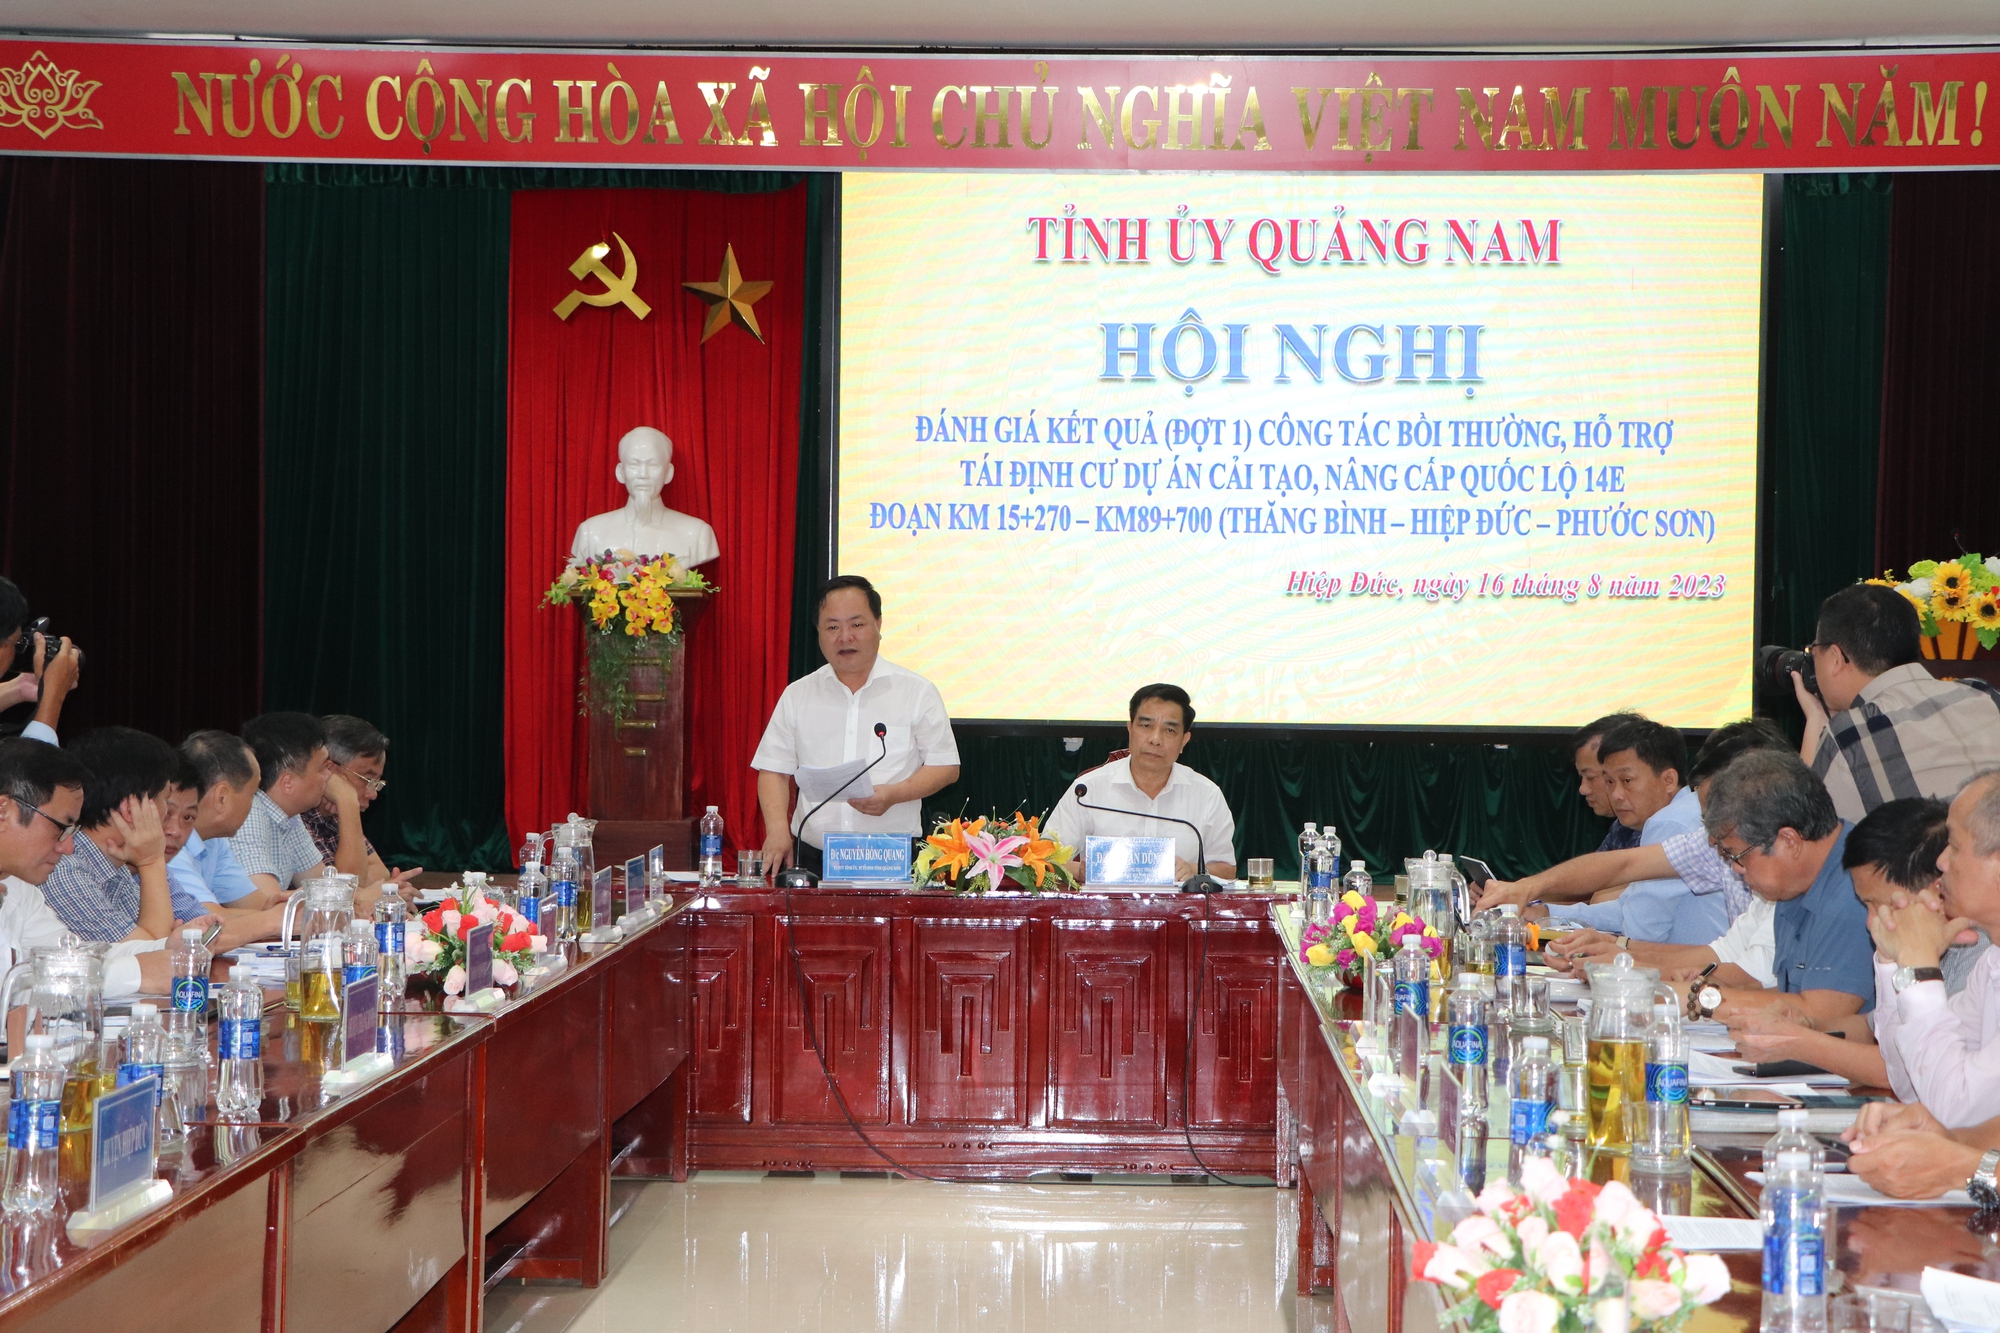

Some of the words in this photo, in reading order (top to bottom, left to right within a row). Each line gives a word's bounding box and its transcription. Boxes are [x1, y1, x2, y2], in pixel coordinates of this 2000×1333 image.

[171, 55, 347, 142] NƯỚC
[364, 58, 535, 156] CỘNG
[553, 62, 686, 146] HÒA
[697, 66, 780, 147] XÃ
[798, 65, 914, 162] HỘI
[930, 60, 1060, 151] CHỦ
[1075, 68, 1275, 152] NGHĨA
[1290, 71, 1435, 165] VIỆT
[1452, 84, 1592, 152] NAM
[1606, 66, 1802, 151] MUÔN
[1815, 63, 1989, 149] NĂM!
[1028, 204, 1149, 262] TỈNH
[1167, 204, 1236, 263] ỦY
[1247, 205, 1430, 273] QUẢNG
[1444, 218, 1563, 264] NAM
[1098, 306, 1252, 396] HỘI
[1274, 322, 1486, 398] NGHỊ
[915, 408, 990, 444] ĐÁNH
[993, 409, 1039, 444] GIÁ
[1046, 409, 1098, 446] KẾT
[1103, 410, 1159, 450] QUẢ
[1164, 417, 1227, 453] (ĐỢT
[1231, 418, 1253, 452] 1)
[1257, 411, 1333, 447] CÔNG
[1338, 412, 1391, 448] TÁC
[1397, 411, 1442, 448] BỒI
[1448, 413, 1568, 453] THƯỜNG,
[1573, 413, 1613, 449] HỖ
[1618, 419, 1674, 456] TRỢ
[960, 453, 1004, 489] TÁI
[1009, 460, 1074, 495] ĐỊNH
[1079, 458, 1119, 490] CƯ
[1123, 458, 1163, 497] DỰ
[1166, 455, 1203, 491] ÁN
[1208, 455, 1254, 491] CẢI
[1259, 463, 1320, 498] TẠO,
[1325, 456, 1398, 493] NÂNG
[1403, 456, 1457, 493] CẤP
[1461, 457, 1535, 498] QUỐC
[1540, 461, 1578, 500] LỘ
[1584, 465, 1627, 493] 14E
[869, 502, 943, 537] ĐOẠN
[947, 503, 990, 531] KM
[996, 503, 1072, 532] 15+270
[1094, 505, 1213, 533] KM89+700
[1218, 500, 1318, 540] (THĂNG
[1323, 500, 1388, 535] BÌNH
[1410, 504, 1472, 542] HIỆP
[1475, 501, 1532, 537] ĐỨC
[1555, 501, 1649, 538] PHƯỚC
[1653, 508, 1717, 544] SƠN)
[1285, 570, 1342, 602] Hiệp
[1349, 570, 1403, 600] Đức,
[1411, 573, 1470, 601] ngày
[1476, 571, 1504, 598] 16
[1511, 571, 1580, 602] tháng
[1586, 573, 1600, 597] 8
[1608, 575, 1660, 598] năm
[1668, 573, 1727, 598] 2023
[883, 848, 905, 863] QUANG
[177, 990, 205, 999] AQUAFINA
[1453, 1040, 1483, 1050] AQUAFINA
